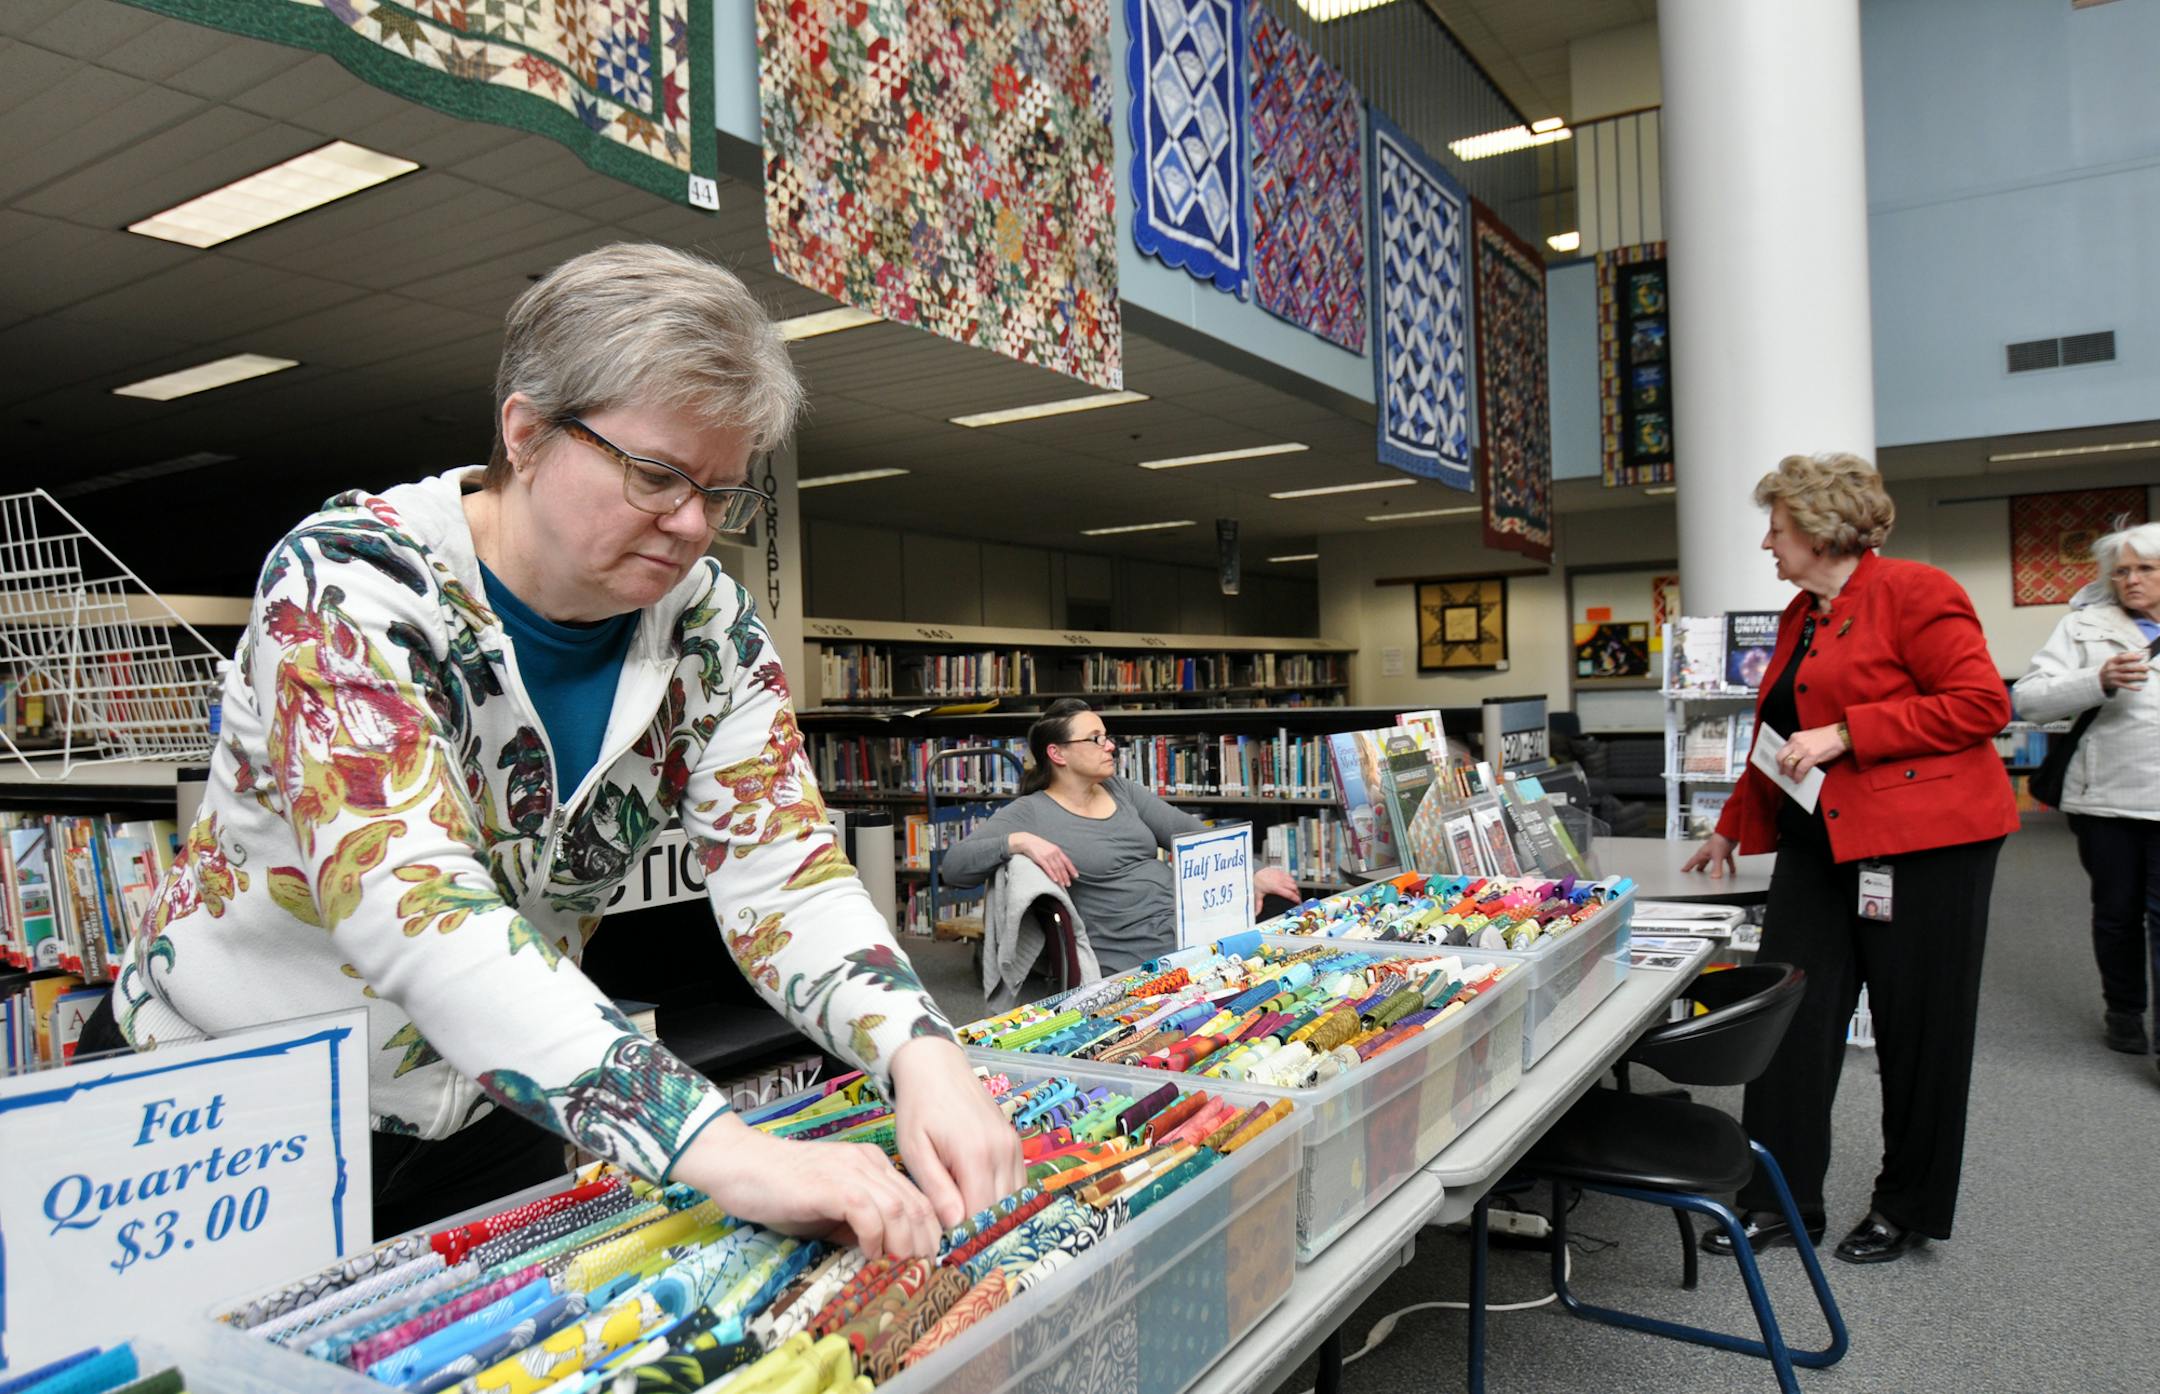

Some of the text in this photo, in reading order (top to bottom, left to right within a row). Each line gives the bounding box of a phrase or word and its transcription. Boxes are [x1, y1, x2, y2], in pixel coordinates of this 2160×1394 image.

[691, 181, 712, 203] 44
[762, 450, 781, 619] IOGRAPHY
[1734, 625, 1779, 634] UNIVER
[1183, 849, 1245, 882] Half Yards
[1202, 883, 1233, 911] $5.95
[132, 1093, 226, 1148] Fat
[42, 1133, 309, 1236] Quarters
[111, 1185, 270, 1275] $3.00
